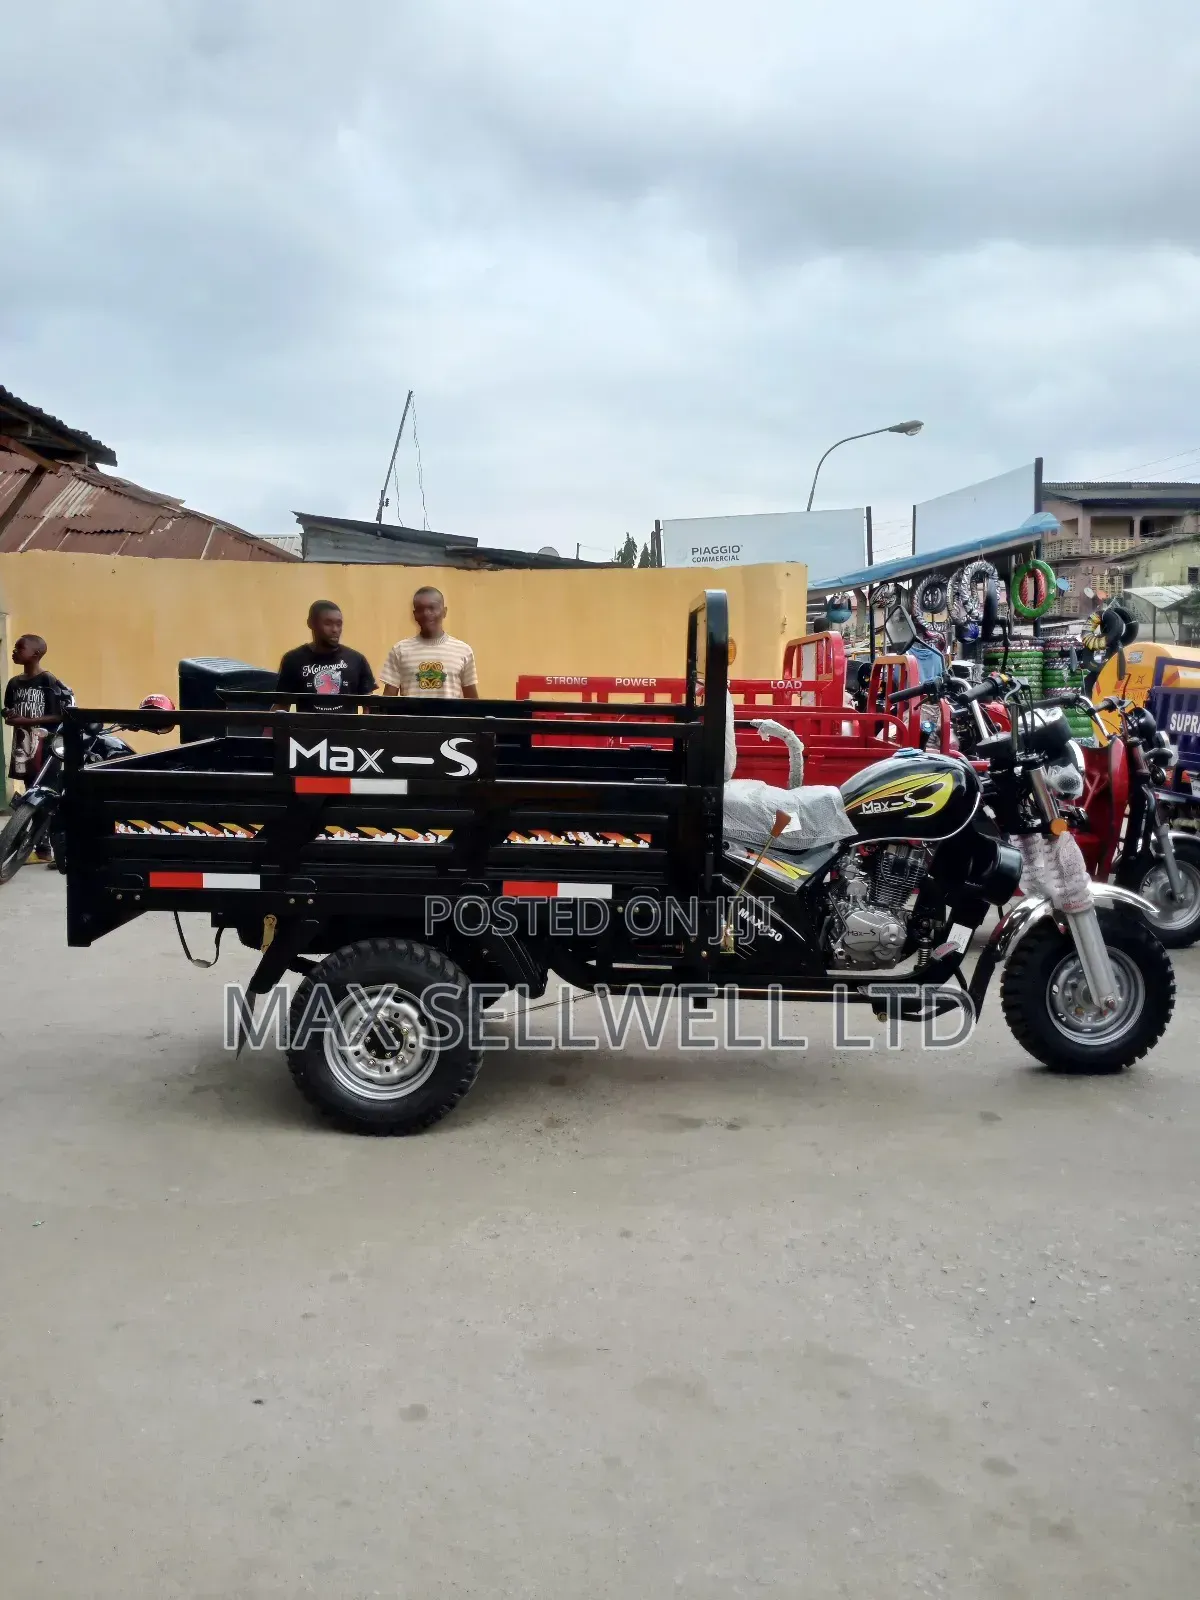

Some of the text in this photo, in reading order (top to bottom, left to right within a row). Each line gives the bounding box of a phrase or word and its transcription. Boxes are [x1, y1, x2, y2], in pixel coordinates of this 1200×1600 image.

[691, 545, 741, 556] PIAGGIO
[691, 554, 740, 563] COMMERCIAL
[545, 676, 657, 687] STRONG POWER
[770, 680, 803, 690] LOAD
